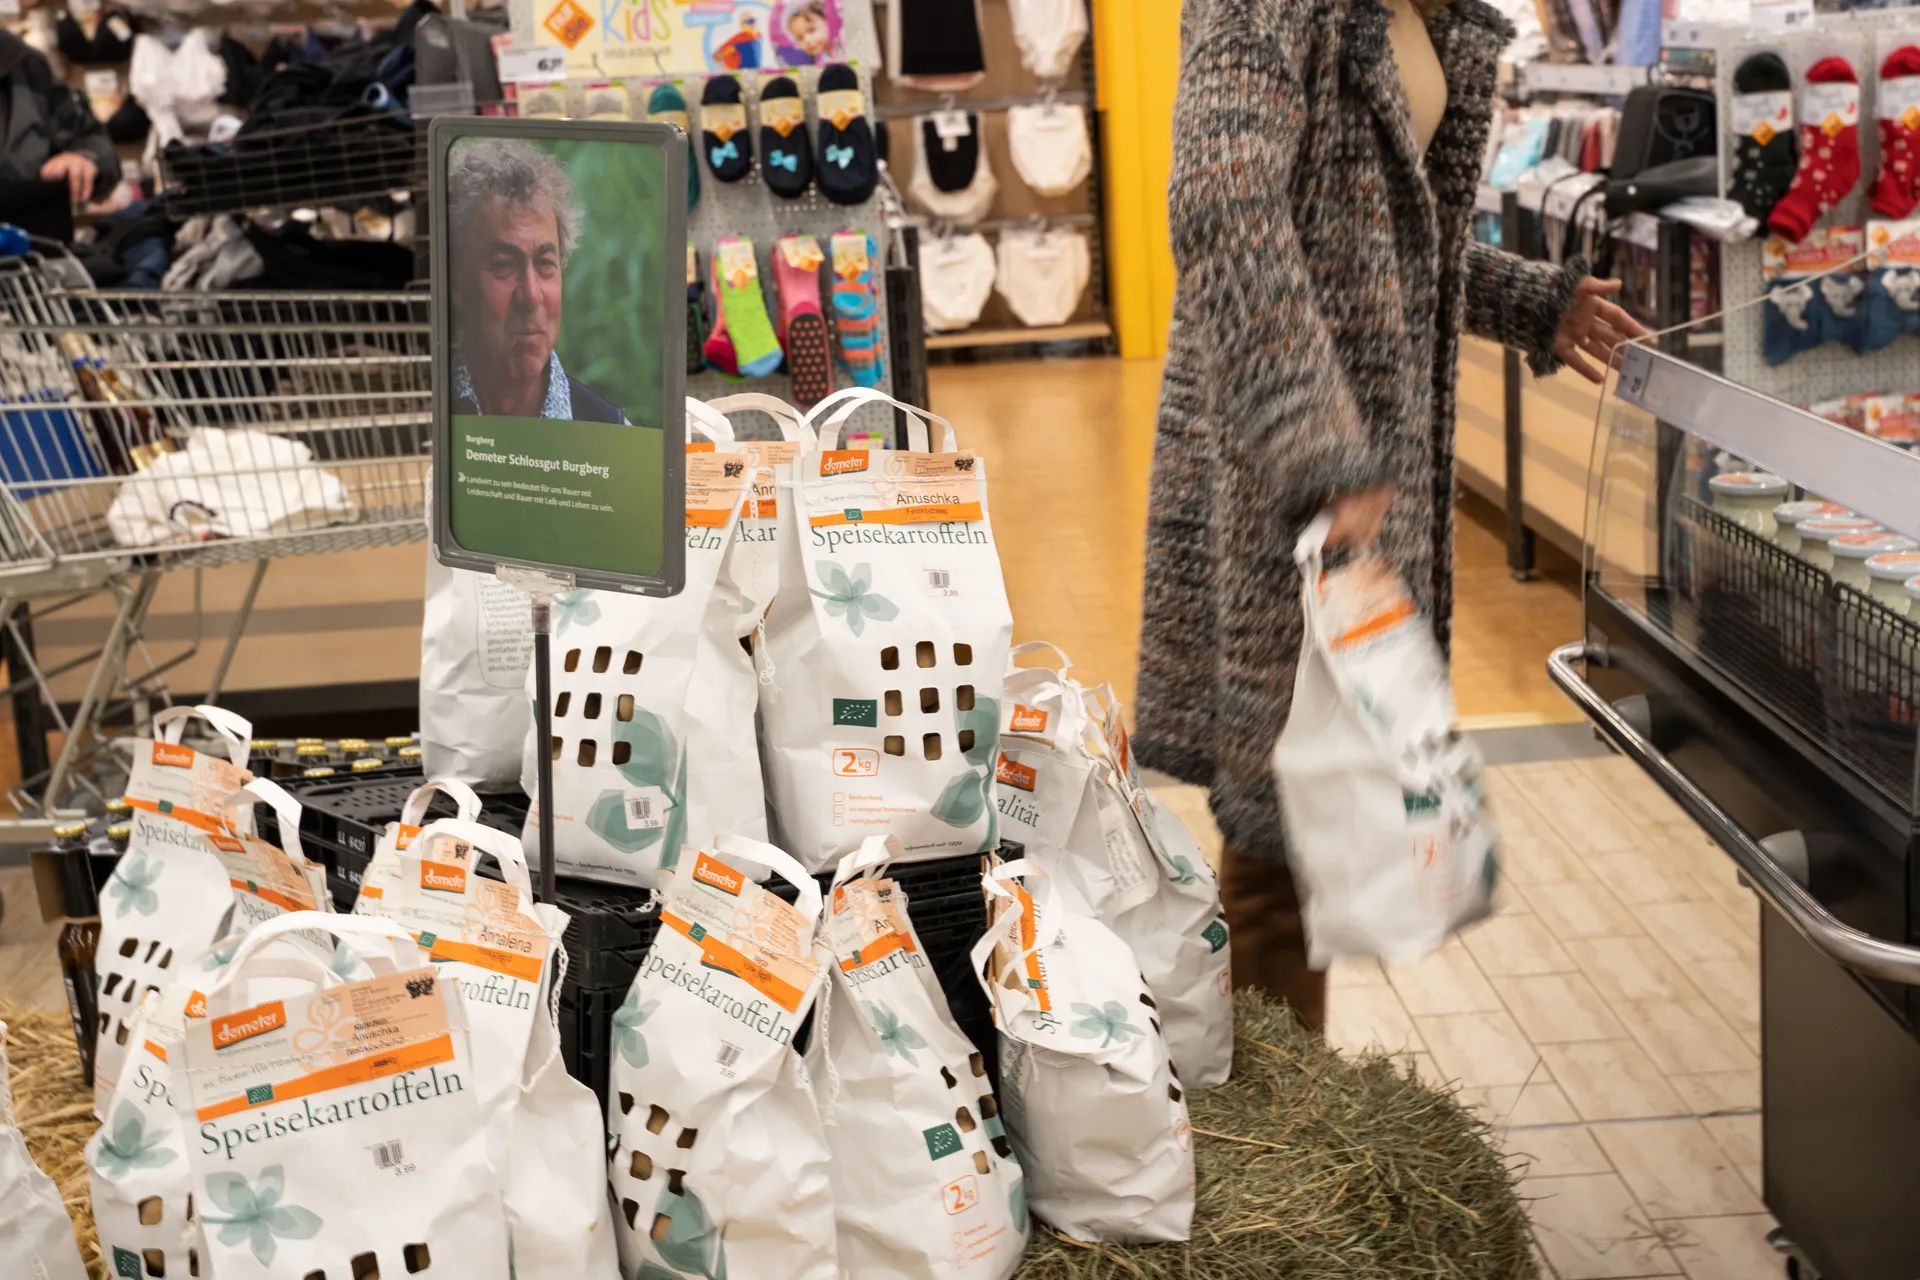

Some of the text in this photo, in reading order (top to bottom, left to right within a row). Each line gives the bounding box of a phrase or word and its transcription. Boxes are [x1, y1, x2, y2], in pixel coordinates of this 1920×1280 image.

[465, 434, 496, 447] Burgberg
[466, 449, 610, 479] Demeter Schlossgut Burgberg
[824, 456, 864, 472] demeter
[466, 475, 492, 486] Landwirt
[501, 480, 513, 488] sein
[513, 480, 541, 492] bedeutet
[540, 484, 551, 494] für
[550, 487, 562, 495] uns
[562, 486, 581, 496] Bauer
[581, 490, 592, 498] mit
[896, 493, 960, 505] Anuschka
[466, 487, 502, 499] Leidenschaft
[503, 492, 516, 500] und
[516, 493, 534, 503] Bauer
[533, 496, 545, 505] mit
[545, 496, 558, 506] Leib
[558, 500, 571, 509] und
[571, 501, 591, 511] Leben
[600, 504, 615, 513] sein.
[812, 522, 988, 553] Speisekartoffeln
[943, 589, 959, 597] 3,99
[841, 752, 871, 773] 2 kg
[698, 862, 738, 889] demeter
[218, 1013, 277, 1042] demeter
[200, 1064, 464, 1160] Speisekartoffeln
[950, 1185, 966, 1210] 2
